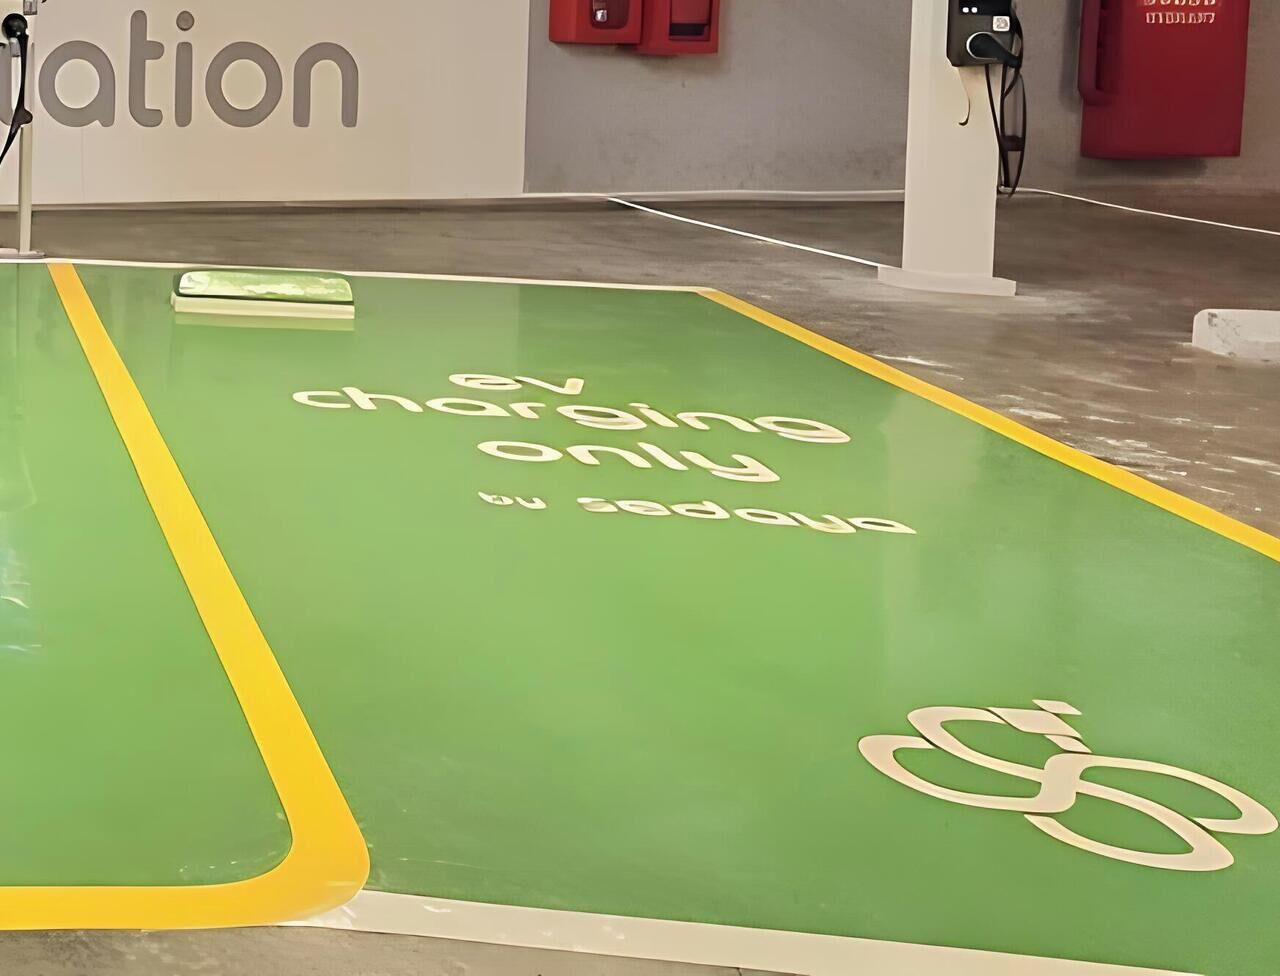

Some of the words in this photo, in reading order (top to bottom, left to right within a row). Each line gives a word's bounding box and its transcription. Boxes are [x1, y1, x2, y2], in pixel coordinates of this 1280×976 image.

[448, 373, 584, 395] ev
[292, 387, 851, 443] charging
[477, 440, 781, 482] only
